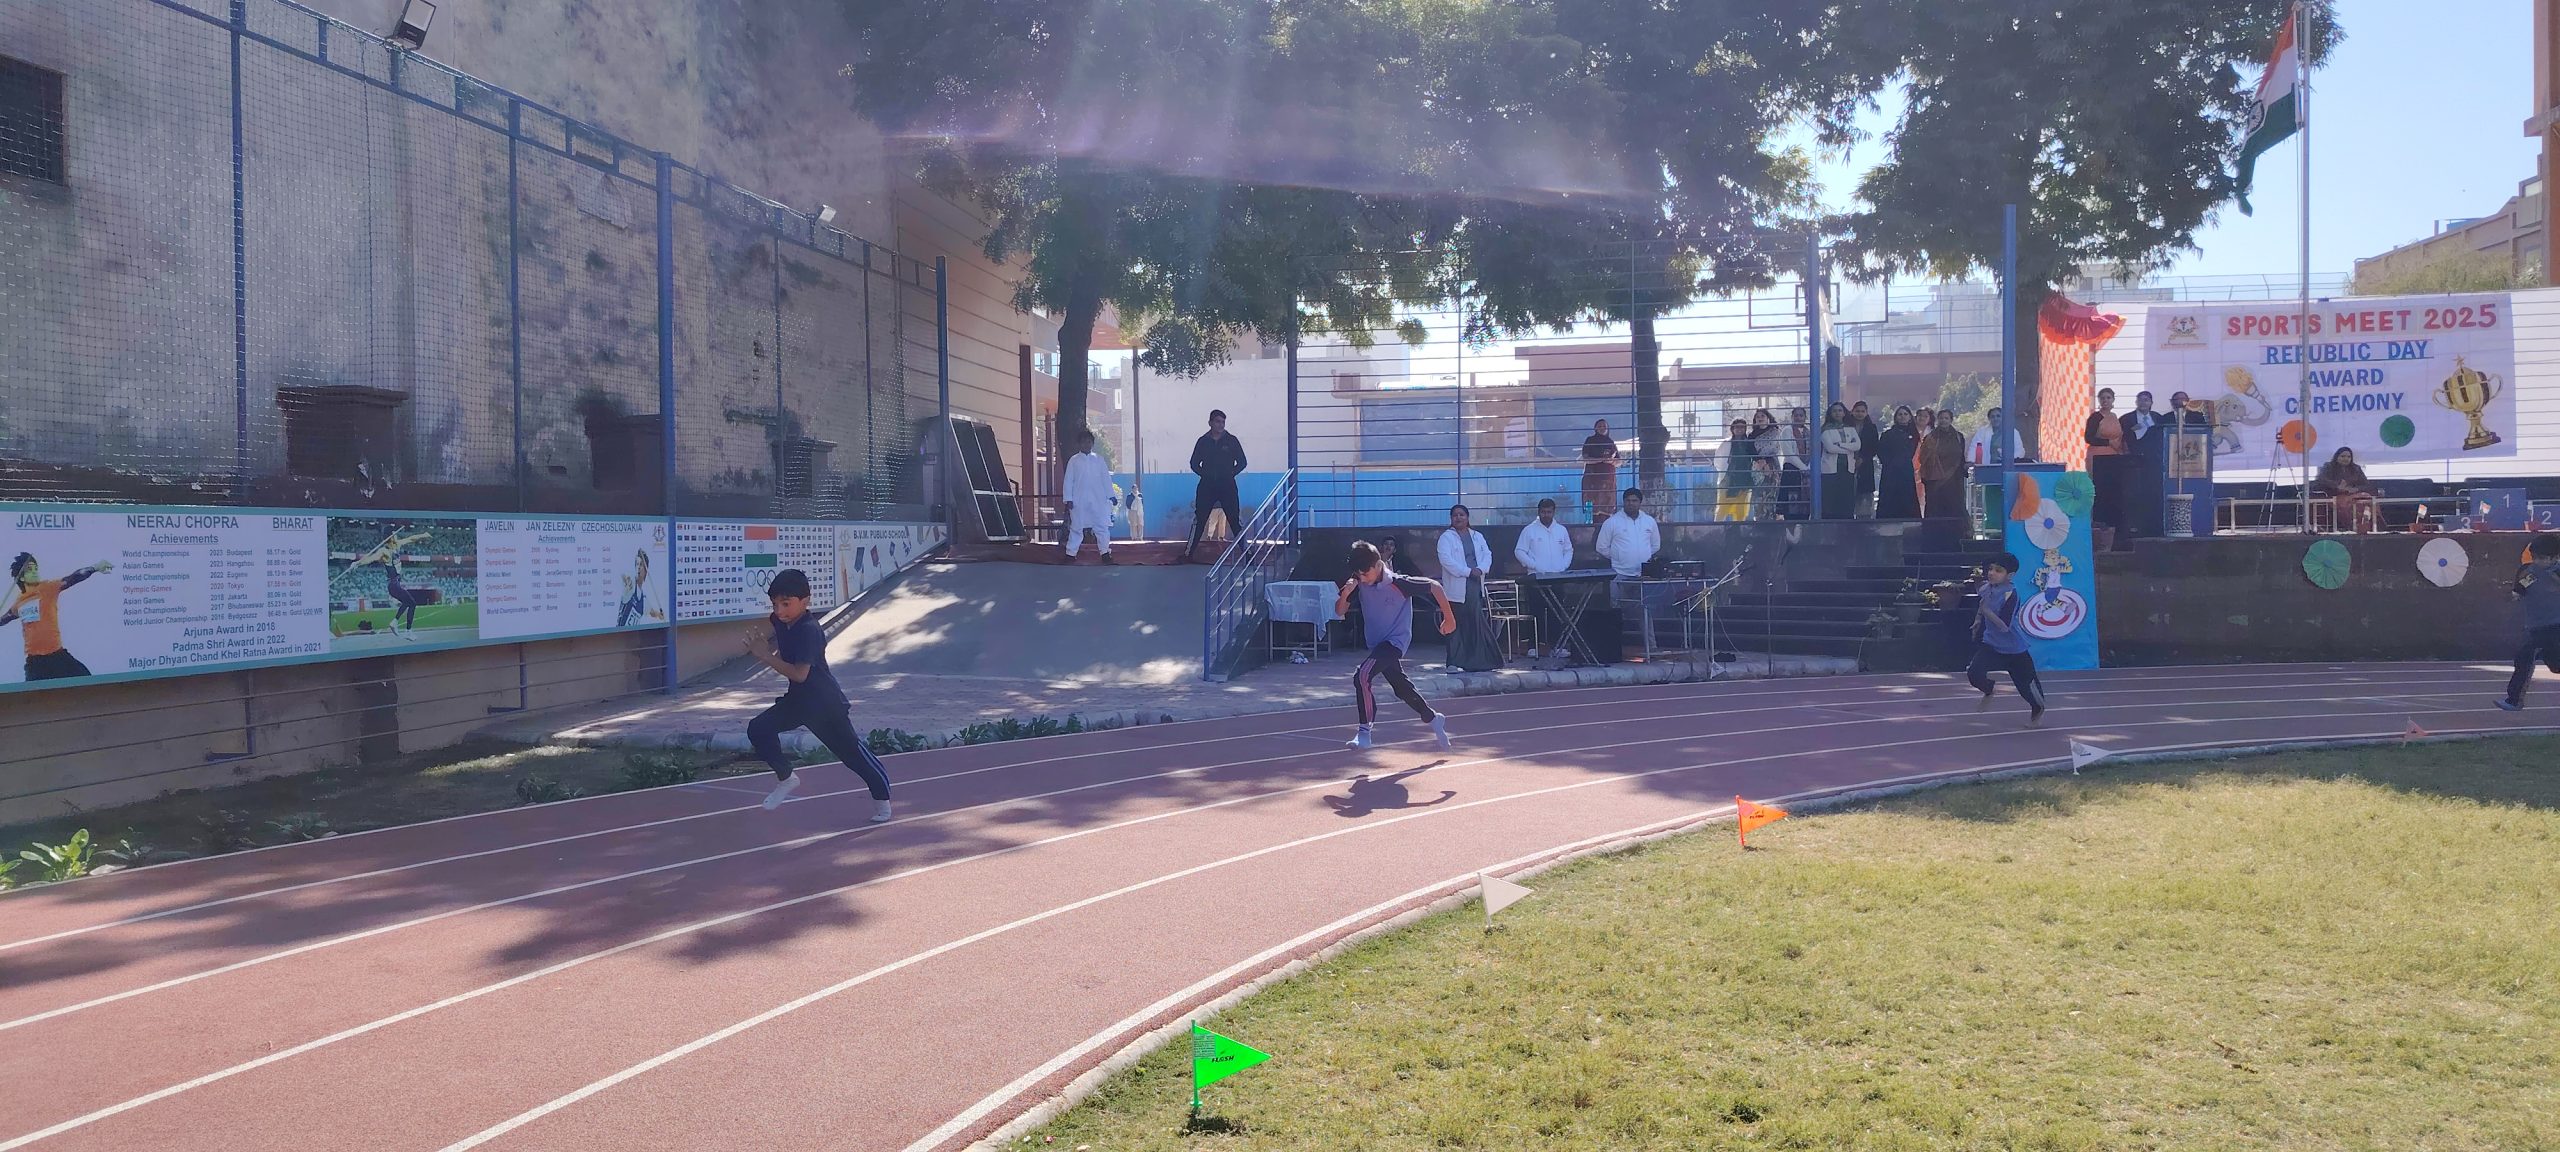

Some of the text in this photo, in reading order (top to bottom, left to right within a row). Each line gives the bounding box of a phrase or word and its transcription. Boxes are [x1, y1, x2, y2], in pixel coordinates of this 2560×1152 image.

[2227, 303, 2497, 336] SPORTS MEET 2025
[2388, 340, 2428, 360] DAY
[2308, 368, 2384, 388] AWARD
[2285, 392, 2404, 414] CREMONY
[2503, 493, 2510, 508] 1
[16, 514, 314, 530] JAVELIN NEERAJ CHOPRA BHARAT
[2461, 517, 2471, 529] 3
[2542, 510, 2552, 525] 2
[485, 521, 643, 532] JAVELIN JAN ZELEZNY CZECHOSLOVAKIA
[150, 533, 219, 544] Achievements
[123, 586, 149, 594] Olympic
[184, 622, 275, 639] Arjuna Award in 2018
[172, 635, 285, 652] Padma Shri Award in 2022
[129, 643, 321, 669] Major Dhyan Chand Khel Ratna Award in 2021
